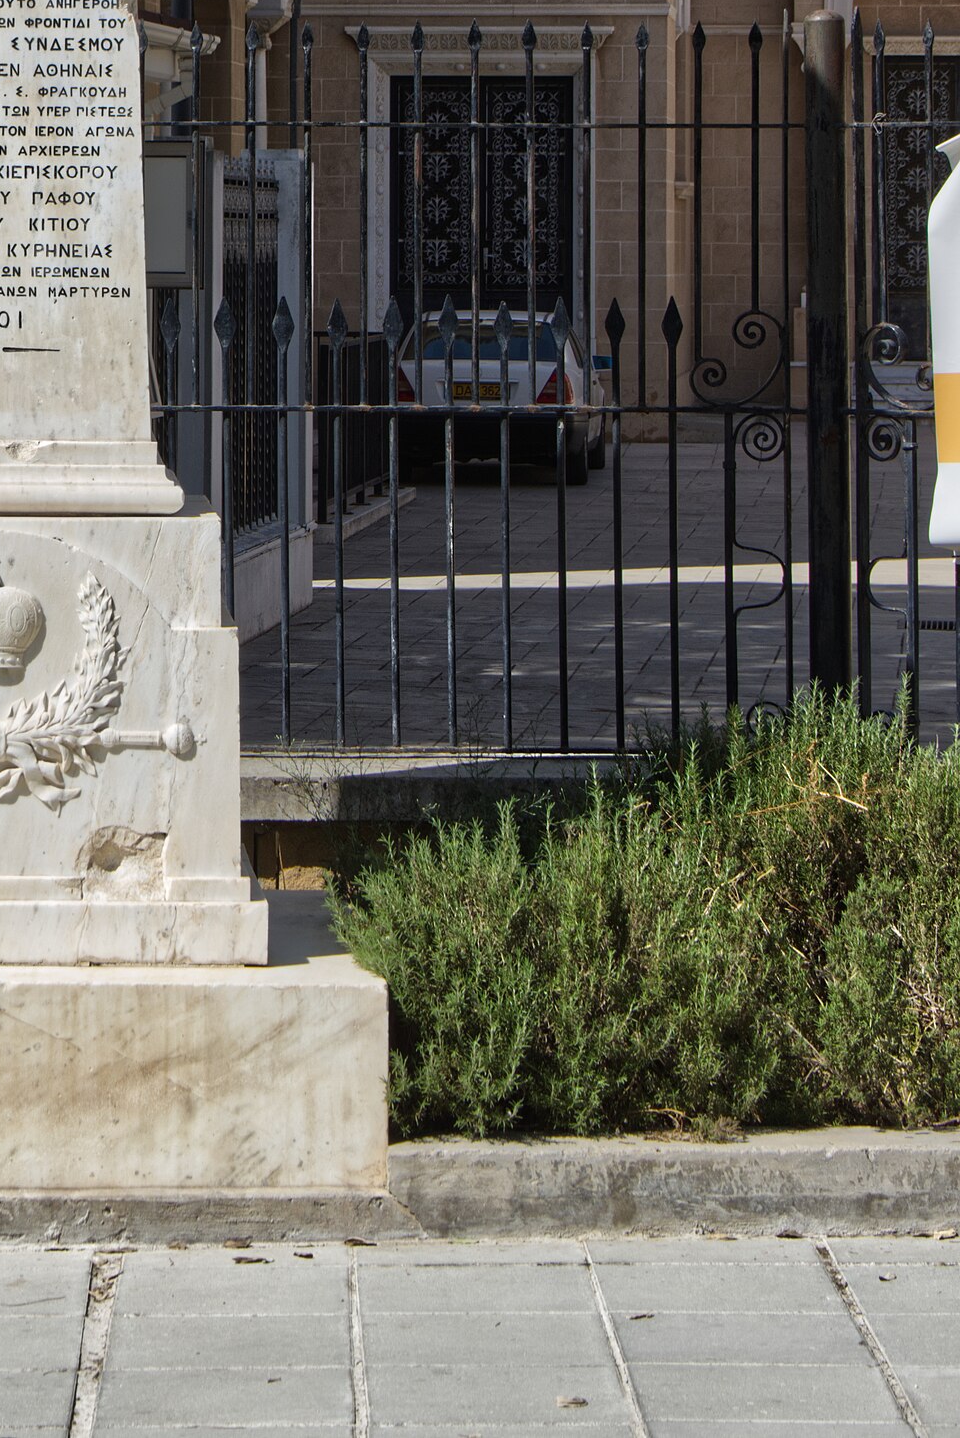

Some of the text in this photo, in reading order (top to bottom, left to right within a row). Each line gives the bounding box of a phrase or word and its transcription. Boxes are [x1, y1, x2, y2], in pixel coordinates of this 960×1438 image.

[25, 18, 90, 29] ΦΡΟΝΤΙΔΙ
[99, 19, 126, 29] ΤΟΥ
[11, 37, 124, 51] ΣΥΝΔΕΣΜΟΥ
[33, 64, 113, 77] ΑΘΗΝΑΙΣ
[38, 86, 126, 98] ΦΡΑΓΚΟΥΔΗ
[2, 106, 29, 116] ΤΩΝ
[37, 106, 70, 117] ΥΠΕΡ
[76, 107, 133, 117] ΠΙΣΤΕΩΣ
[0, 125, 26, 136] ΤΟΝ
[35, 126, 73, 137] ΙΕΡΟΝ
[85, 126, 134, 137] ΑΓΩΝΑ
[18, 145, 100, 156] ΑΡΧΙΕΡΕΩΝ
[32, 191, 96, 205] ΠΑΦΟΥ
[29, 218, 90, 231] ΚΙΤΙΟΥ
[8, 244, 113, 258] ΚΥΡΗΝΕΙΑΣ
[31, 267, 110, 278] ΙΕΡΩΜΕΝΩΝ
[48, 287, 131, 298] ΜΑΡΤΥΡΩΝ
